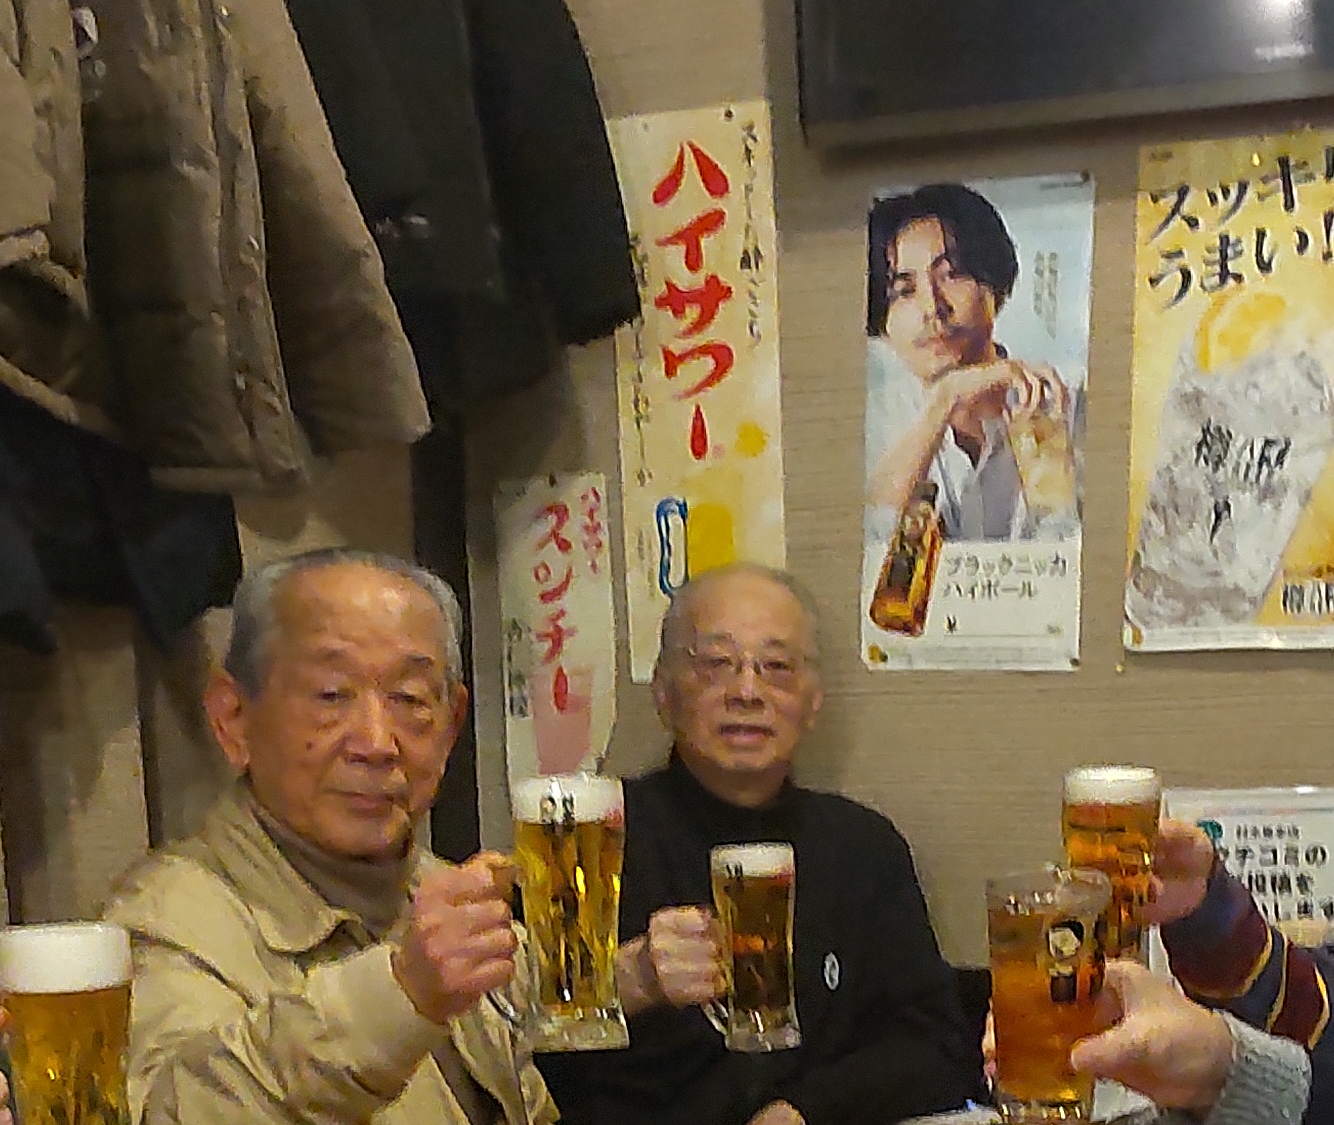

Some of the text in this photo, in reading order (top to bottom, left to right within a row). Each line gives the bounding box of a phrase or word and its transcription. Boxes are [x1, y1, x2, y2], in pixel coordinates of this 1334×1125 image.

[652, 139, 734, 462] ハイサワー
